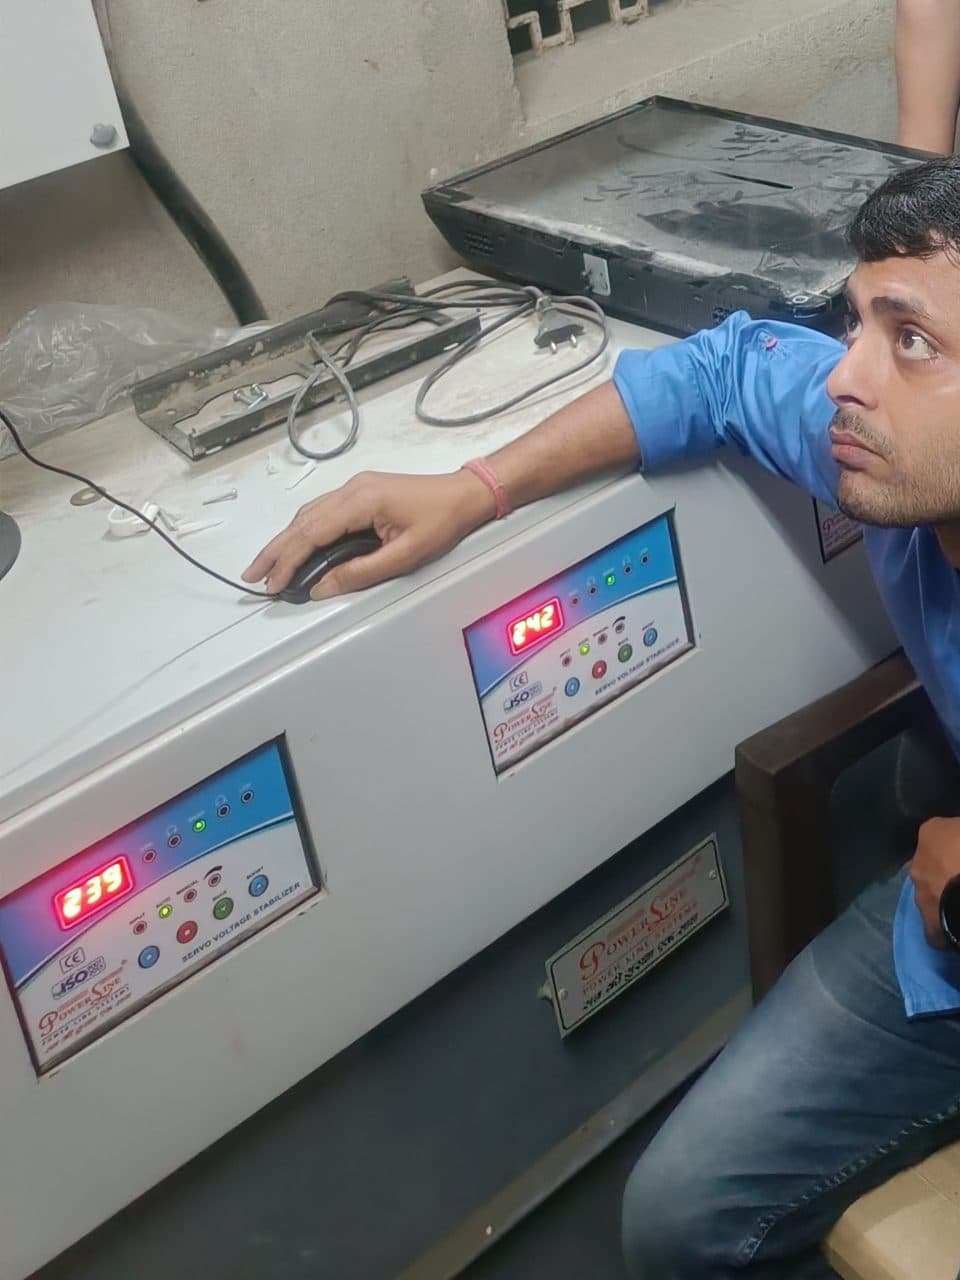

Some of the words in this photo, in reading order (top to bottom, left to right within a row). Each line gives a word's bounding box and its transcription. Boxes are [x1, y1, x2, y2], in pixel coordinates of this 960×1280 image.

[512, 604, 555, 646] 242
[617, 661, 643, 681] VOLTAGE
[61, 863, 123, 920] 239
[182, 940, 212, 963] SERVO
[213, 914, 252, 942] VOLTAGE
[253, 882, 300, 916] STABILIZER
[65, 952, 80, 968] CE
[60, 970, 88, 992] ISO
